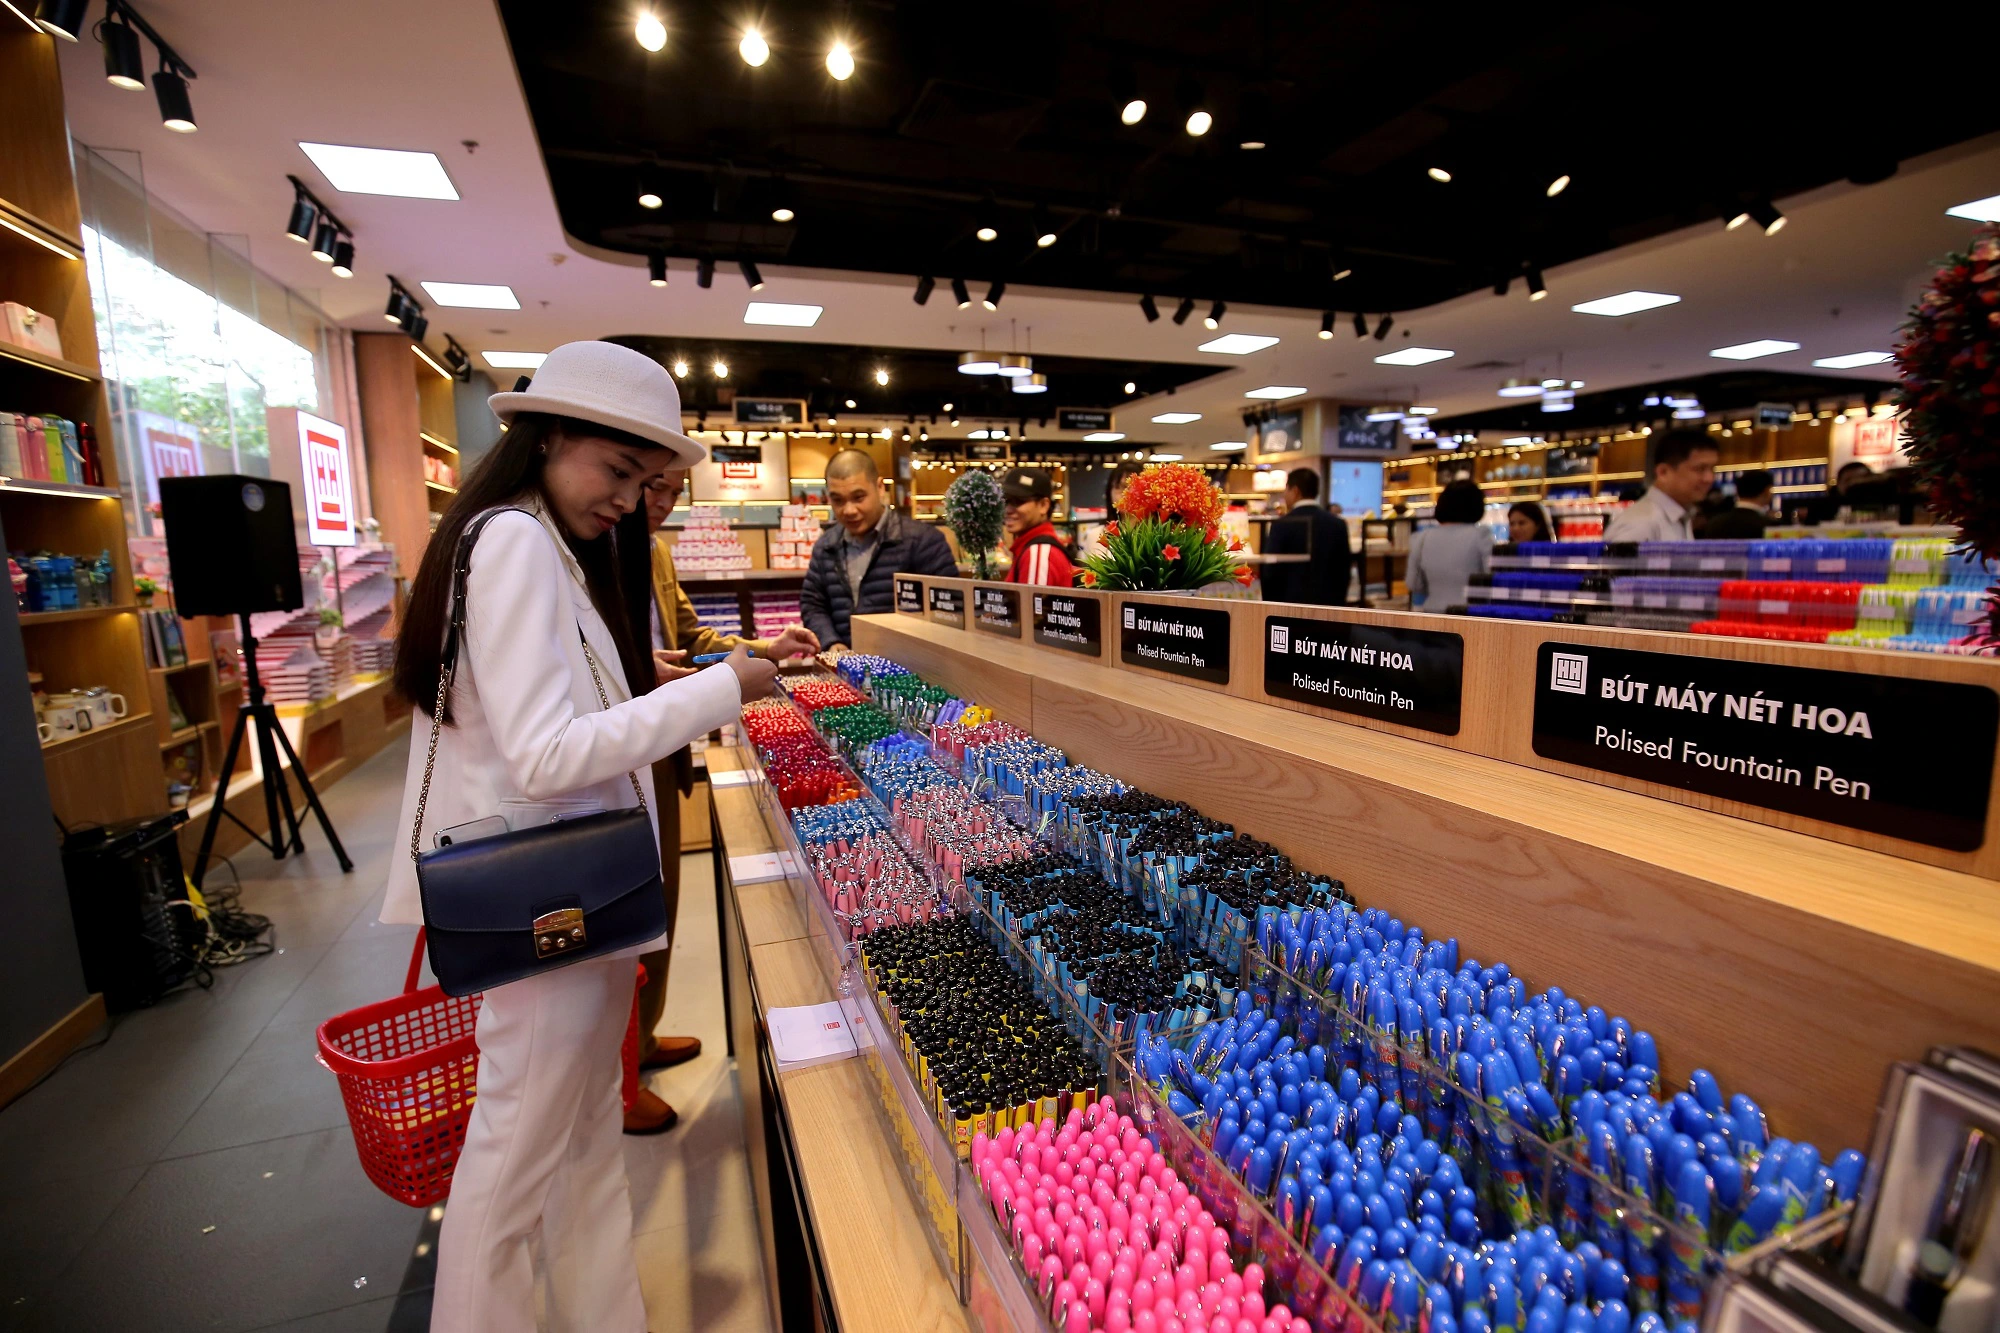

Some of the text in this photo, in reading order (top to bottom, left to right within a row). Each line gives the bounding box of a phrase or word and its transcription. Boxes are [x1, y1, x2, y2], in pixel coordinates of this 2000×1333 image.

[1047, 611, 1057, 624] NÉT
[1052, 598, 1075, 613] BÚT MÁY
[1043, 626, 1088, 644] Smooth Fountain Pen
[1138, 616, 1204, 640] BÚT MÁY NÉT HOA
[1137, 643, 1205, 668] Polised Fountain Pen
[1295, 638, 1414, 672] BÚT MÁY NÉT HOA
[1293, 672, 1414, 711] Polised Fountain Pen
[1601, 674, 1873, 739] BÚT MÁY NÉT HOA
[1595, 725, 1871, 800] Polised Fountain Pen
